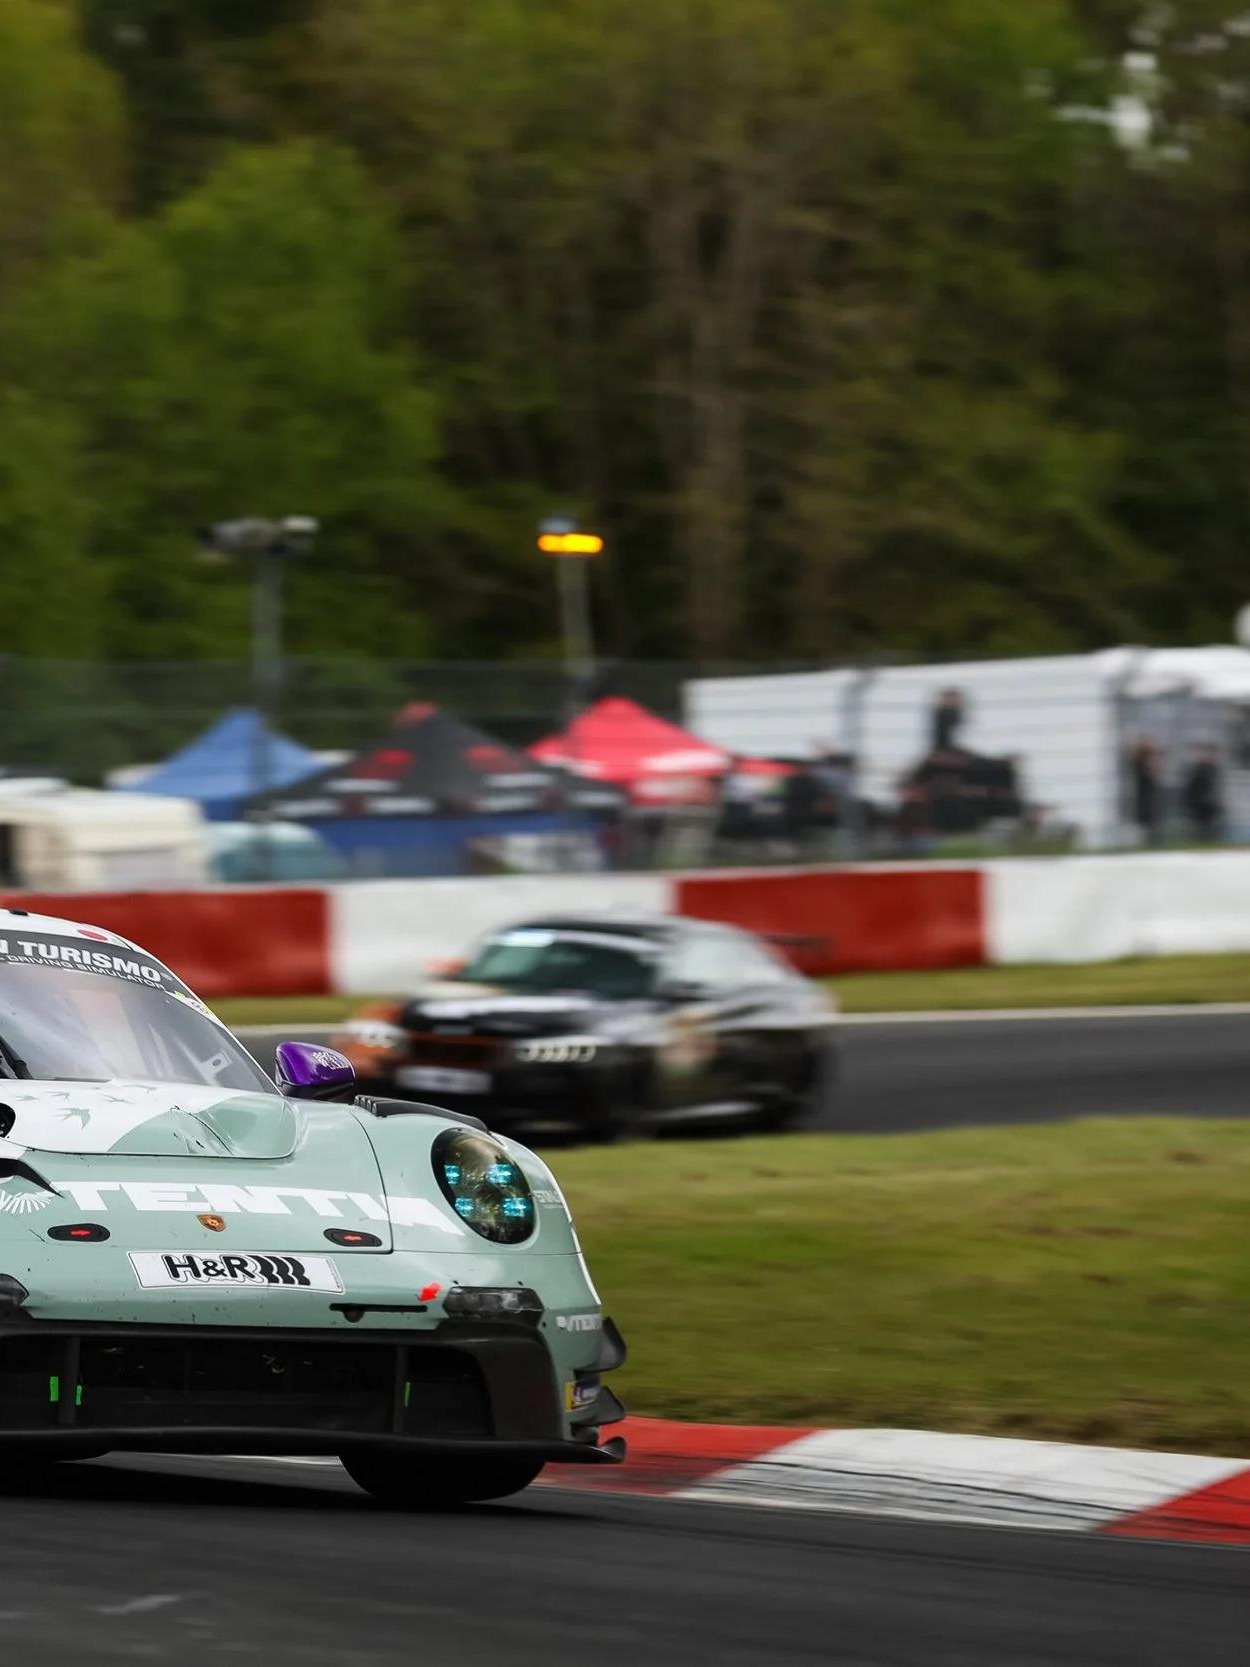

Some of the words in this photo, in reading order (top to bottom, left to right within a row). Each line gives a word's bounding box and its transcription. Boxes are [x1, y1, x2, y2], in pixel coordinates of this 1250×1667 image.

[7, 954, 73, 969] DRIVING
[75, 963, 167, 991] SIMULATOR
[17, 940, 162, 983] TURISMO
[163, 1254, 256, 1280] H&R
